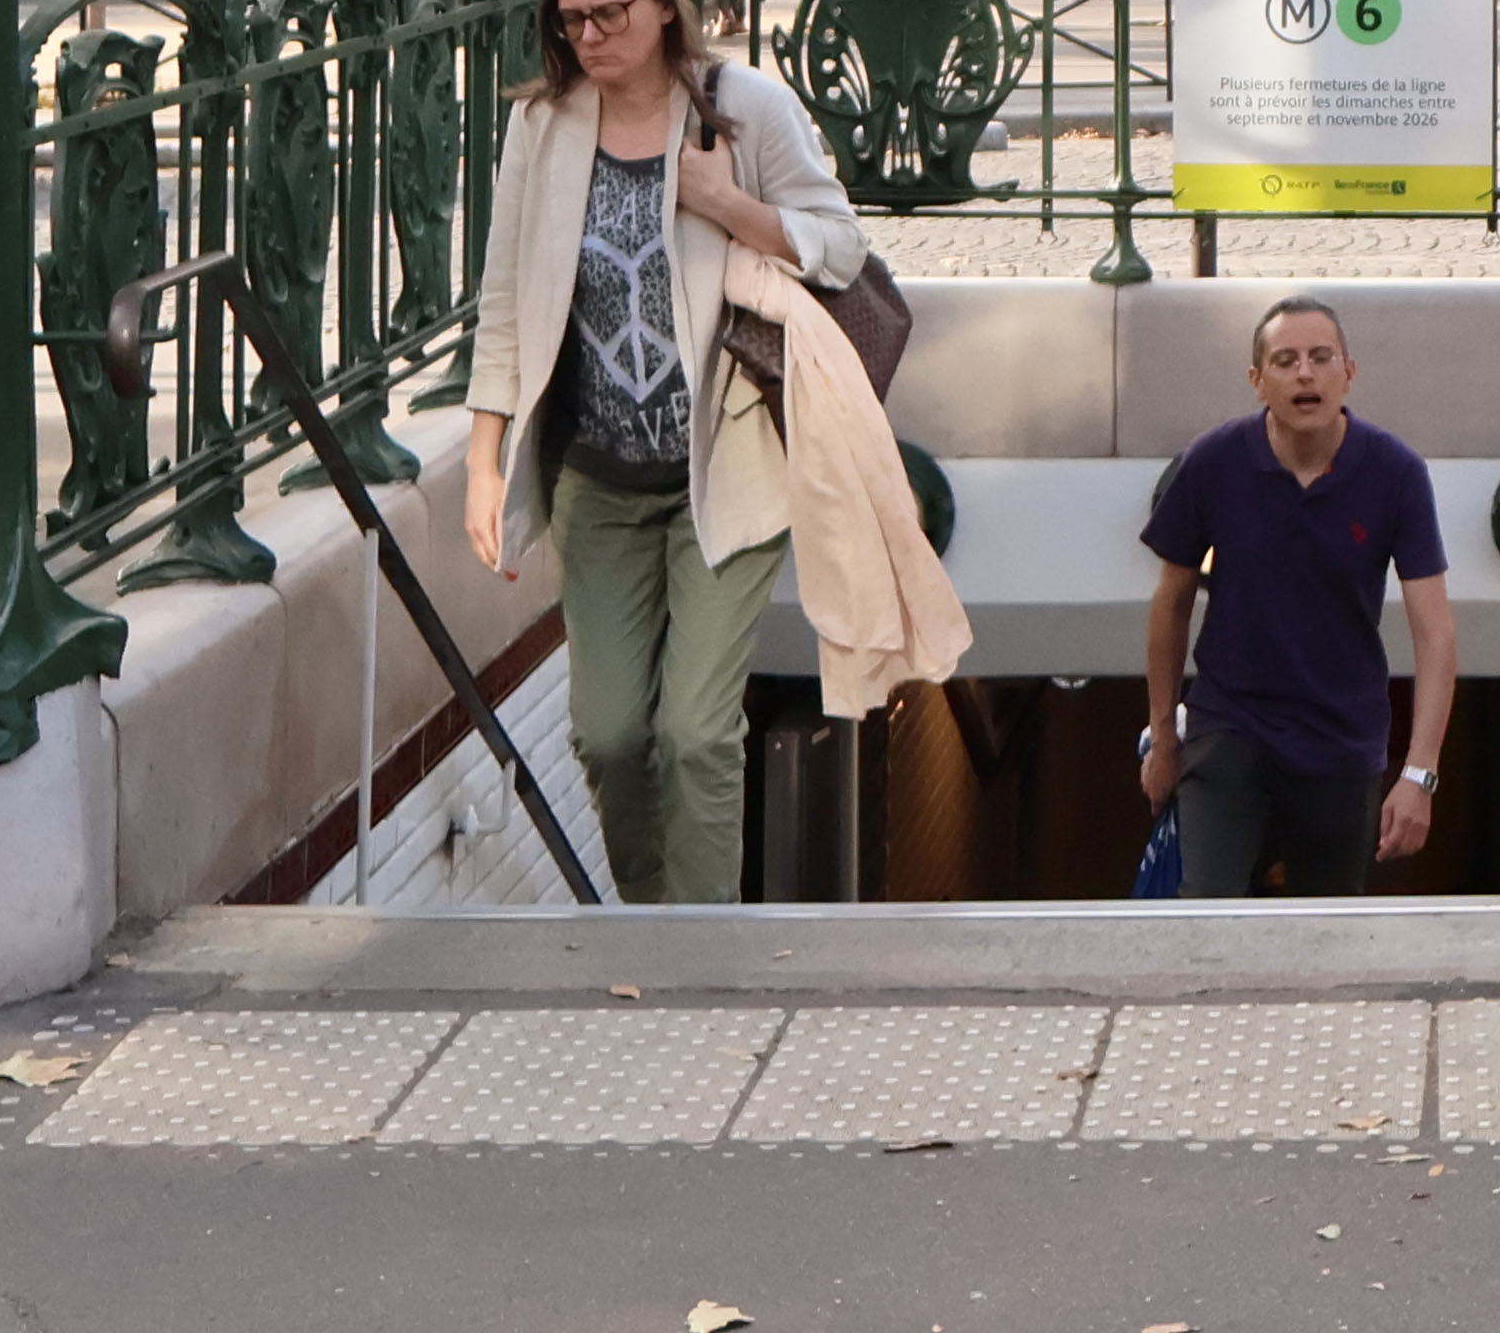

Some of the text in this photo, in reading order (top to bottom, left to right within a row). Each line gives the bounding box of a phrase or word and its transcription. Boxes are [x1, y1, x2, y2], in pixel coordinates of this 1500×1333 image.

[1220, 77, 1446, 96] Plusieurs fermetures de la ligne
[1210, 94, 1457, 113] sont à prévoir les dimanches entre
[1226, 112, 1439, 130] septembre et novembre 2026
